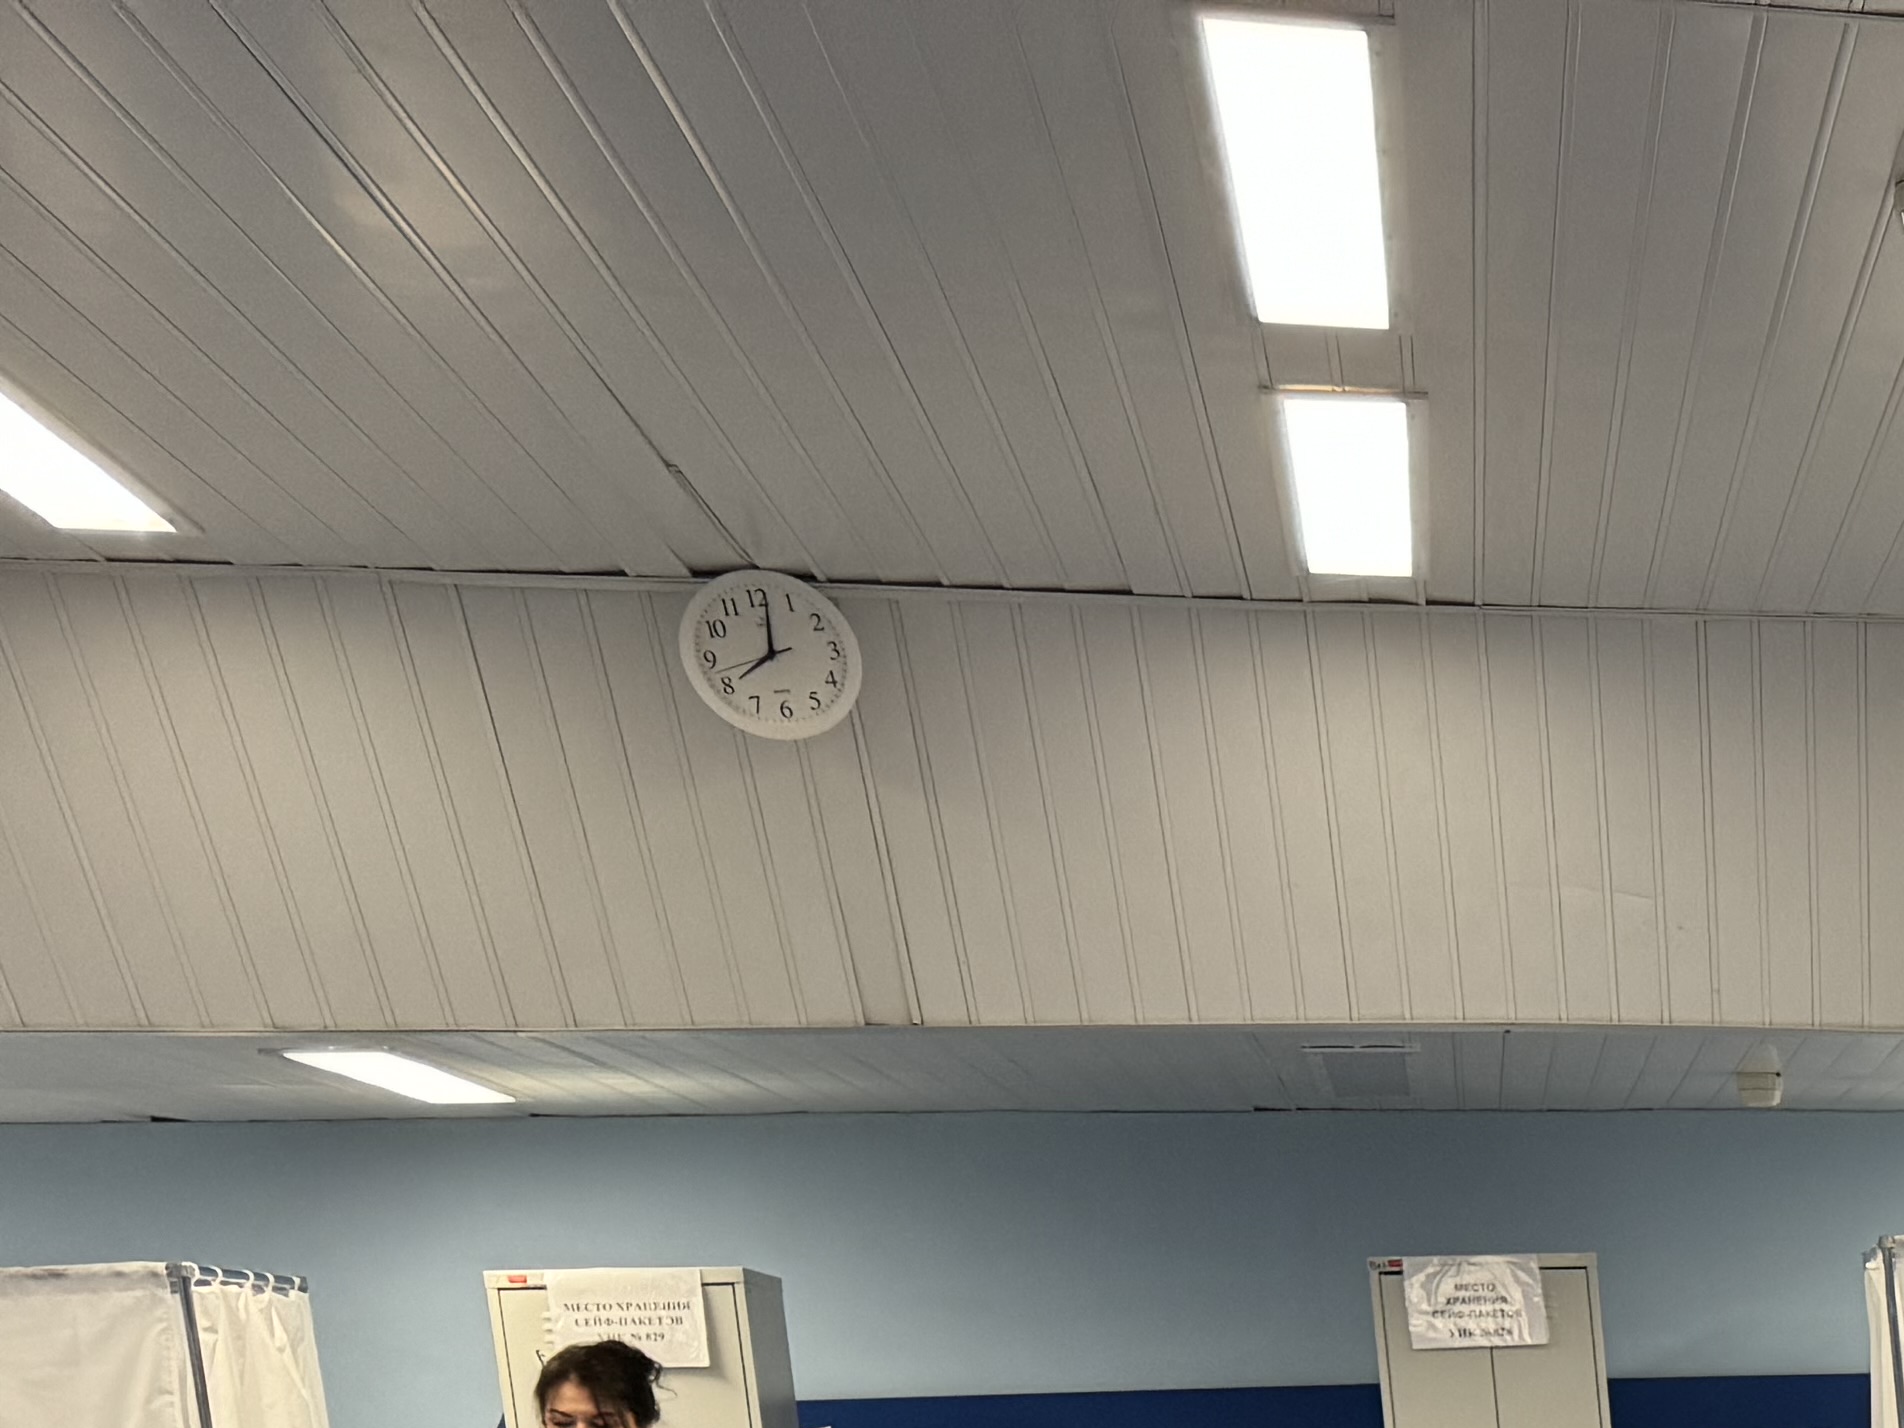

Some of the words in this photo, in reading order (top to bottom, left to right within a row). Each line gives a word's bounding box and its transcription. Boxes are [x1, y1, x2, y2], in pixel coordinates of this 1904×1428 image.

[721, 598, 739, 616] 11
[746, 588, 769, 608] 12
[785, 593, 795, 612] 1
[705, 619, 727, 638] 10
[810, 613, 825, 632] 2
[703, 650, 717, 670] 9
[828, 641, 841, 661] 3
[721, 676, 735, 695] 8
[825, 670, 838, 688] 4
[748, 696, 761, 714] 7
[779, 700, 794, 719] 6
[808, 692, 822, 711] 5
